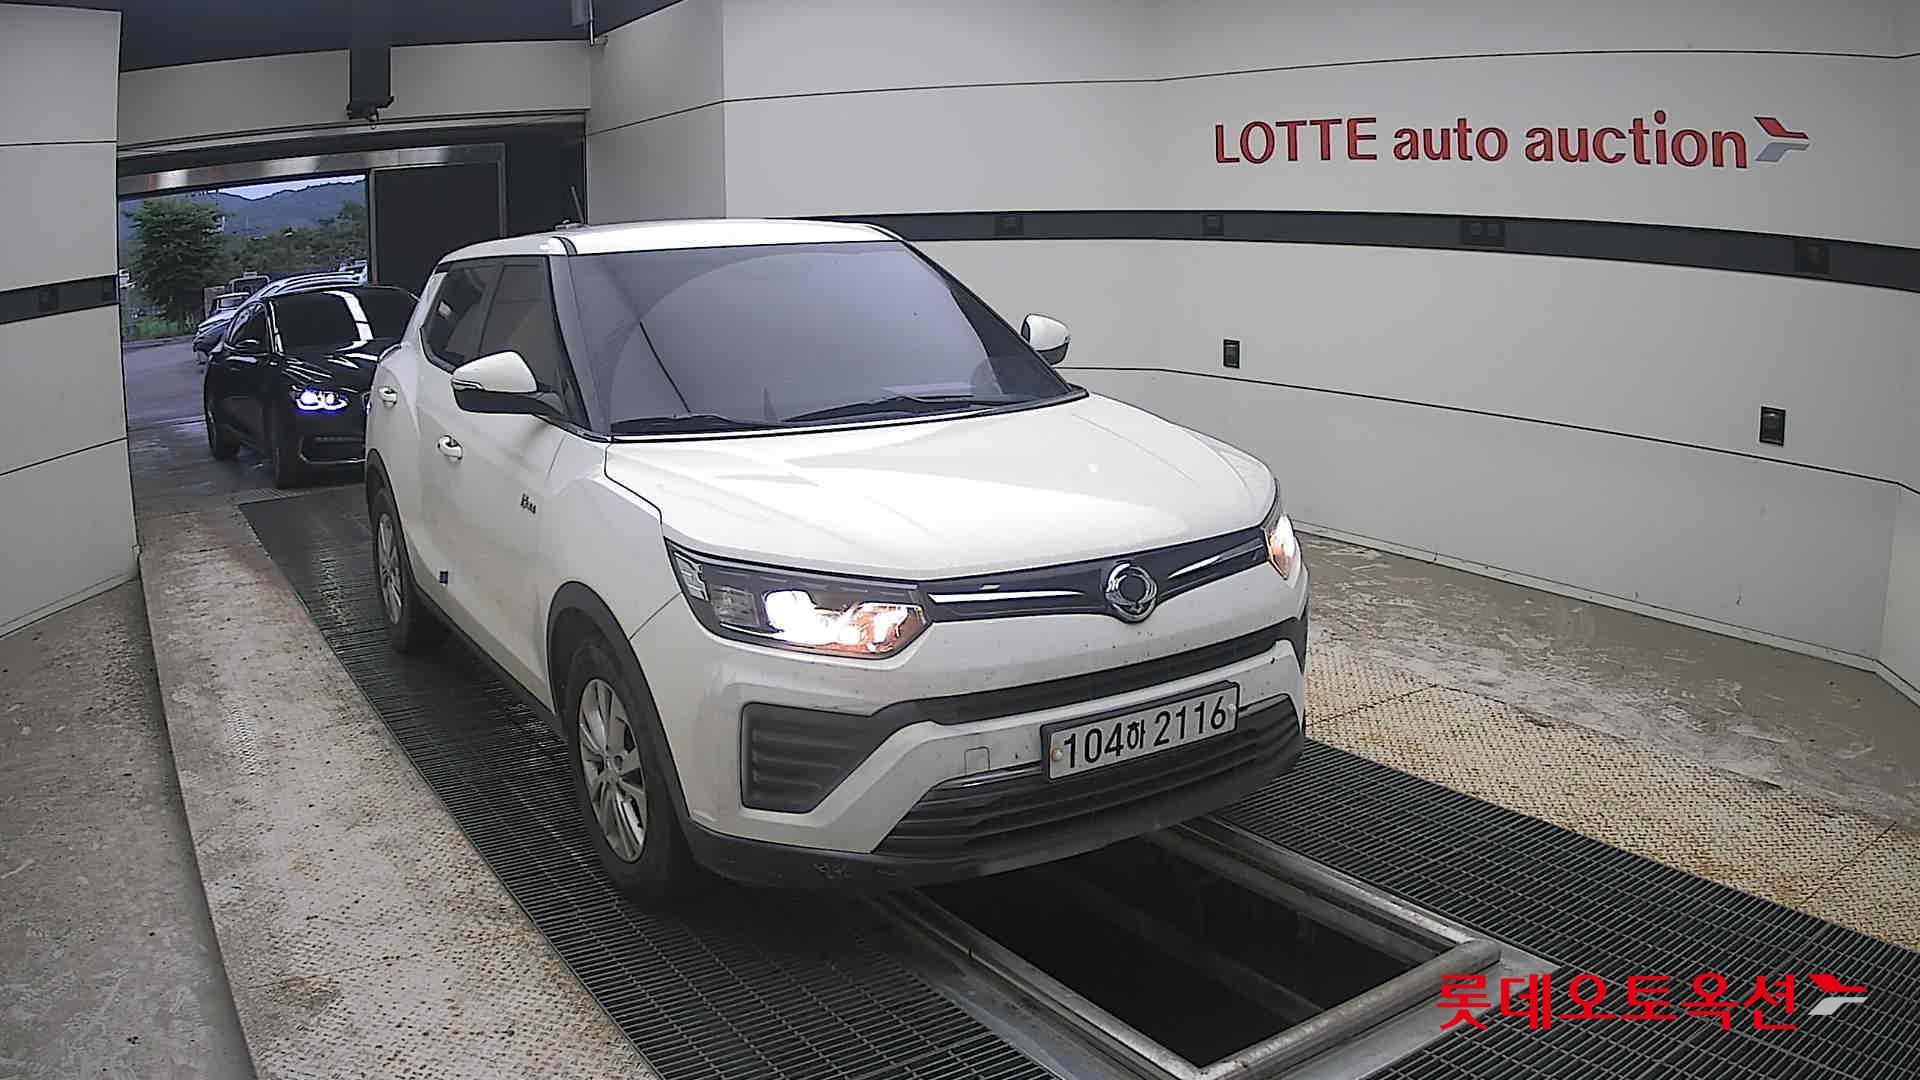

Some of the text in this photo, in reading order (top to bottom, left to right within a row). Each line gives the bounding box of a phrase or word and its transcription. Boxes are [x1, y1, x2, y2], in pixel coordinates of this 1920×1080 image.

[1215, 109, 1748, 169] LOTTE auto auction
[1063, 695, 1227, 769] 104하 2116
